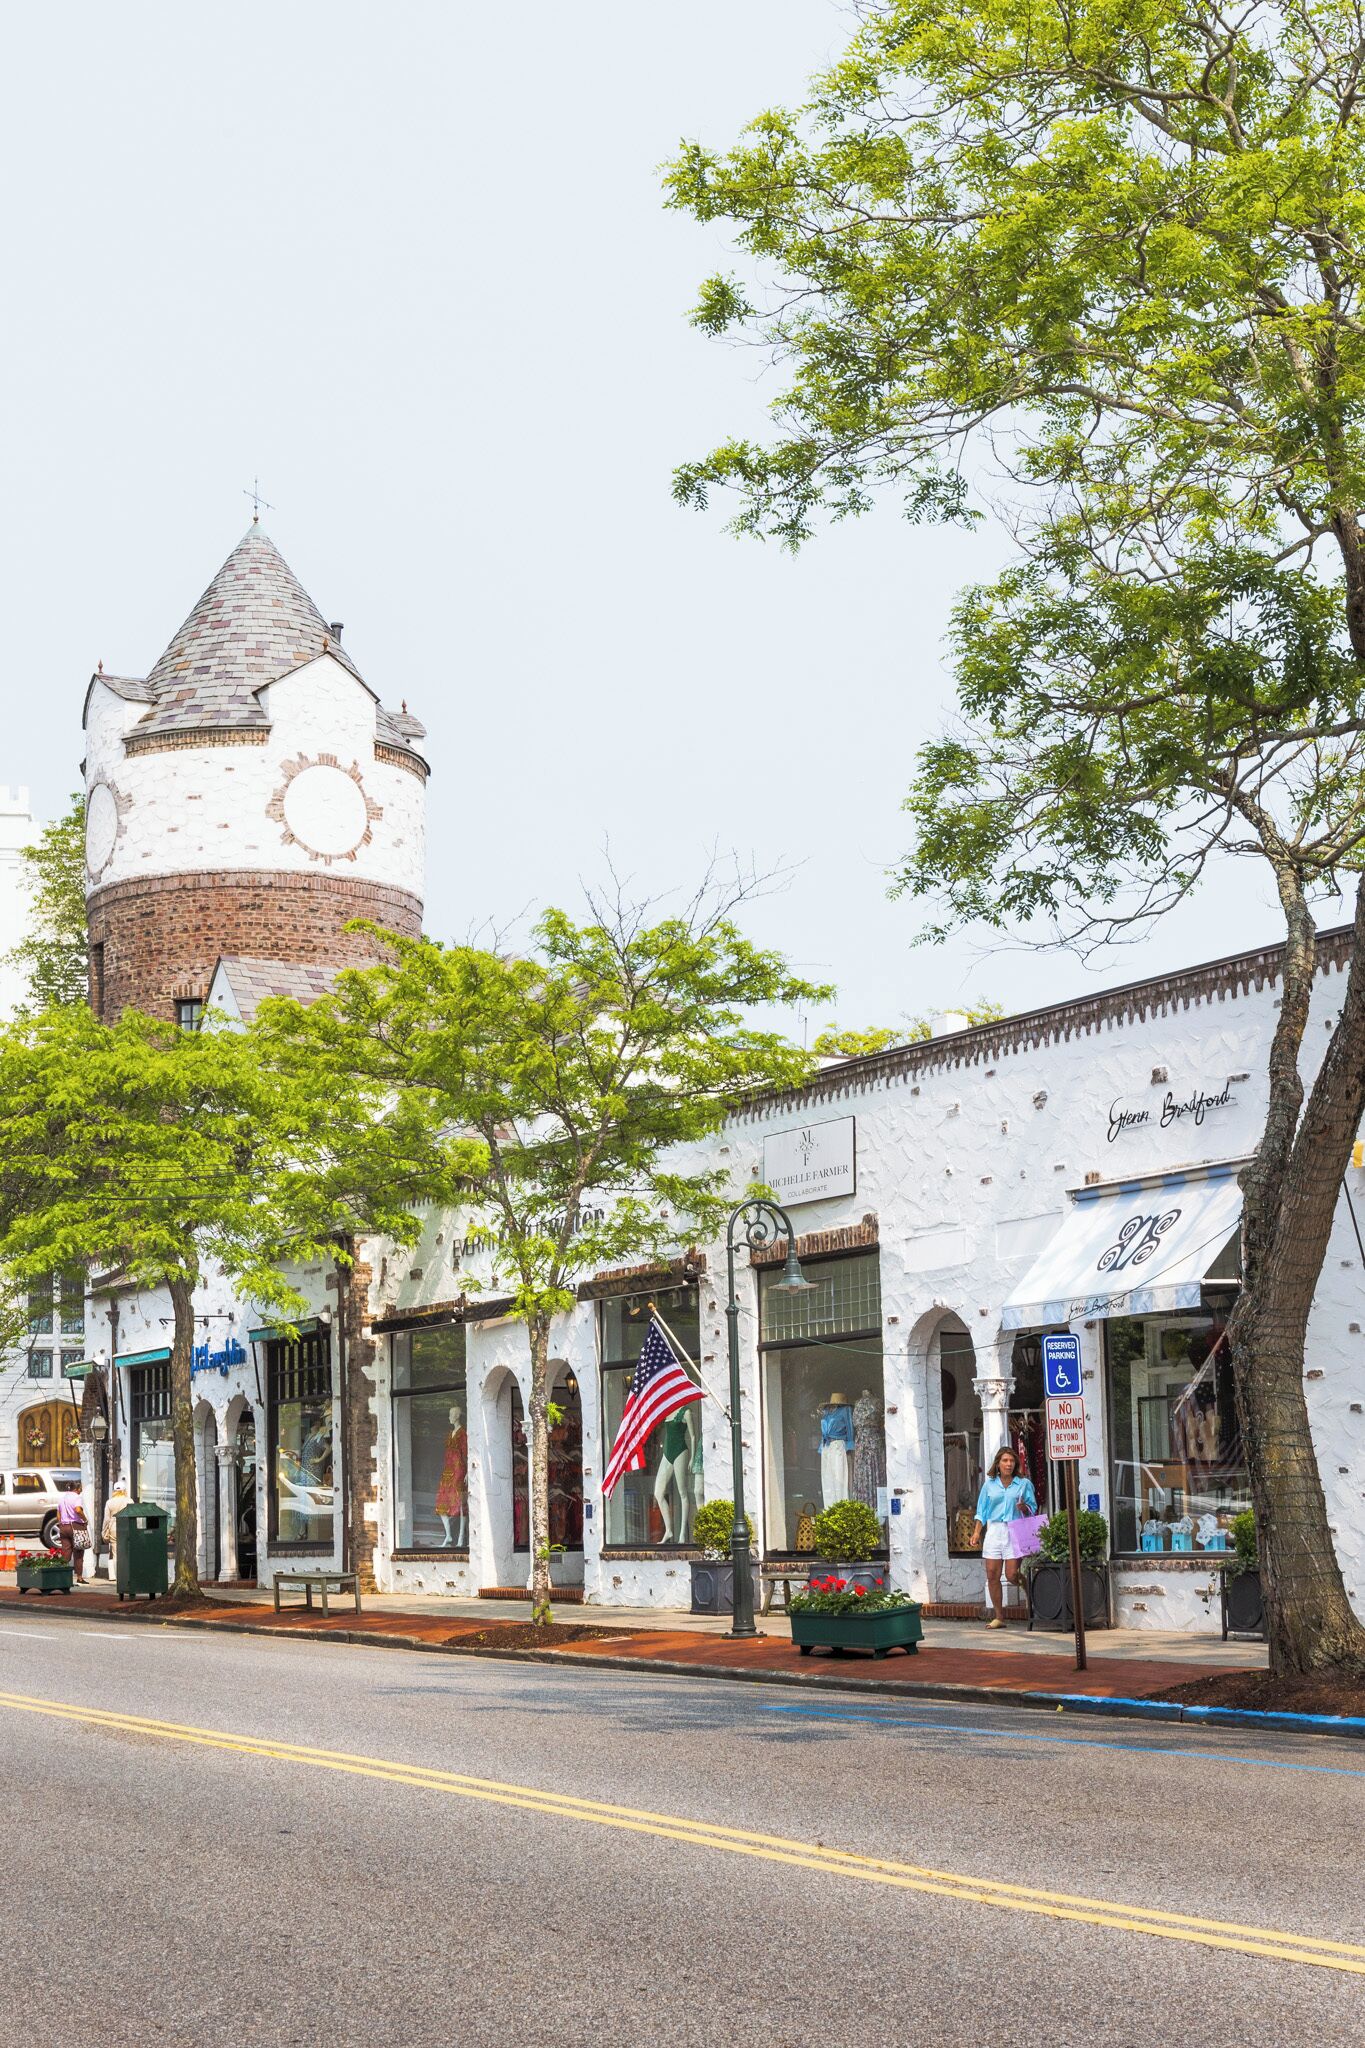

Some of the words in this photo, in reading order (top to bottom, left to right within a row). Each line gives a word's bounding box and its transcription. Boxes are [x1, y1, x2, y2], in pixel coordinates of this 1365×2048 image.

[1160, 1082, 1236, 1129] Bradford
[768, 1172, 812, 1189] MICHELLE
[812, 1164, 849, 1181] FARMER
[787, 1184, 828, 1199] COLLABORATE
[1047, 1341, 1076, 1350] RESERVED
[1048, 1351, 1076, 1360] PARKING
[1058, 1403, 1072, 1415] NO
[1050, 1417, 1083, 1431] PARKING
[1055, 1432, 1079, 1442] BEYOND
[1052, 1445, 1065, 1454] THIS
[1067, 1443, 1084, 1453] POINT
